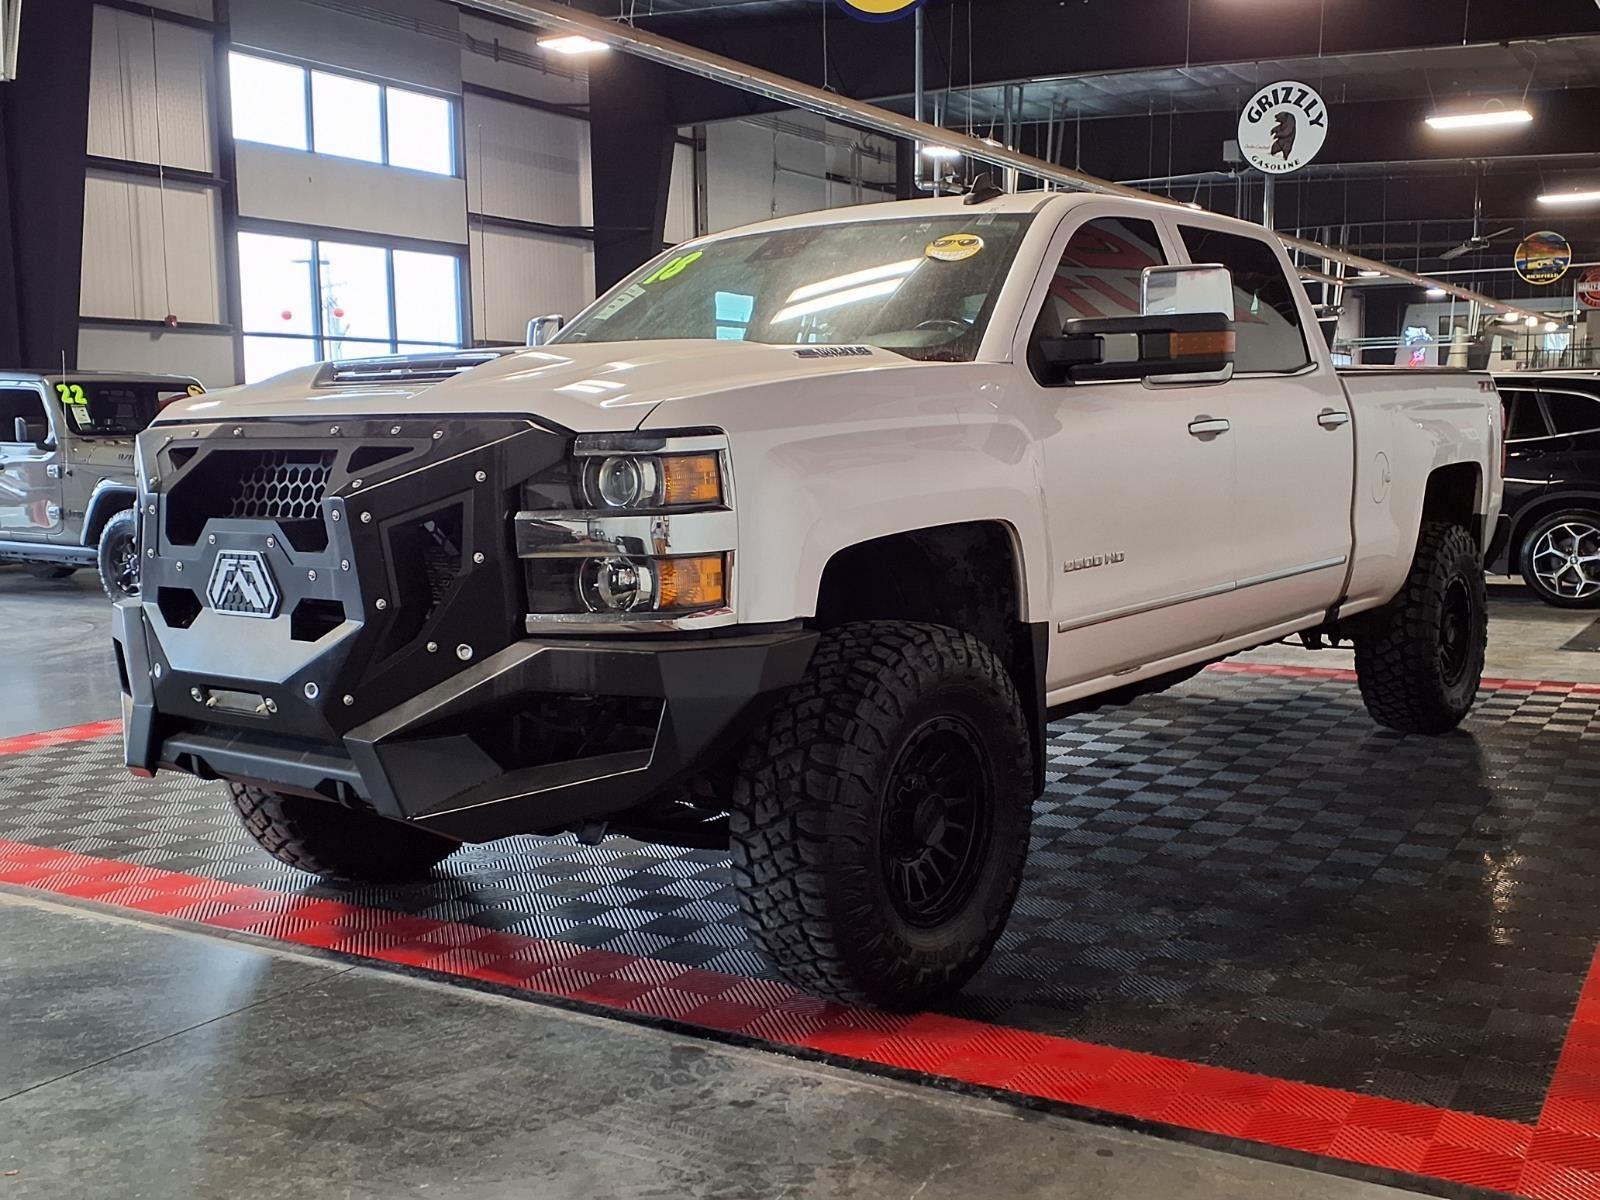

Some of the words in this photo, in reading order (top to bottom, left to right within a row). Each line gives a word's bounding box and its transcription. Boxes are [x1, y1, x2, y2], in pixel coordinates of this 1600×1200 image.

[1247, 86, 1324, 128] GRIZZLY
[1251, 155, 1301, 171] GASOLINE
[56, 384, 88, 405] 22
